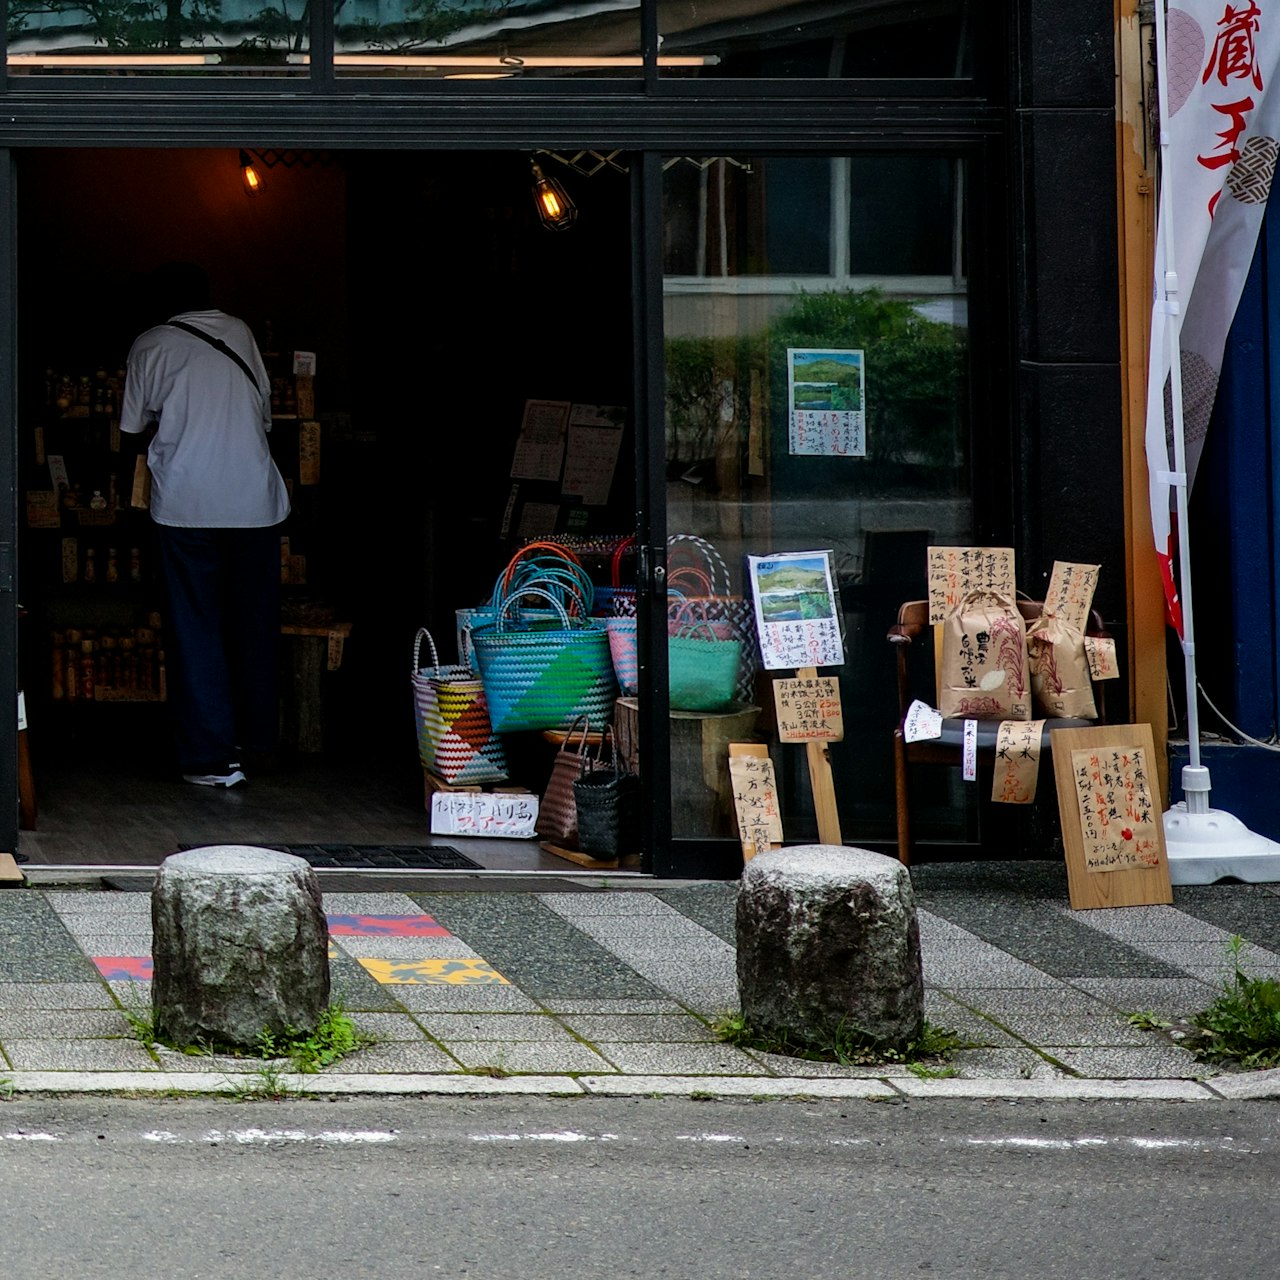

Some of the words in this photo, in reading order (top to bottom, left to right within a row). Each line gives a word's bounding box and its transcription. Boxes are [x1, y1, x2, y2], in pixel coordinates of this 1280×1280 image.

[434, 800, 486, 815] インドネシア
[492, 802, 533, 821] バリ島
